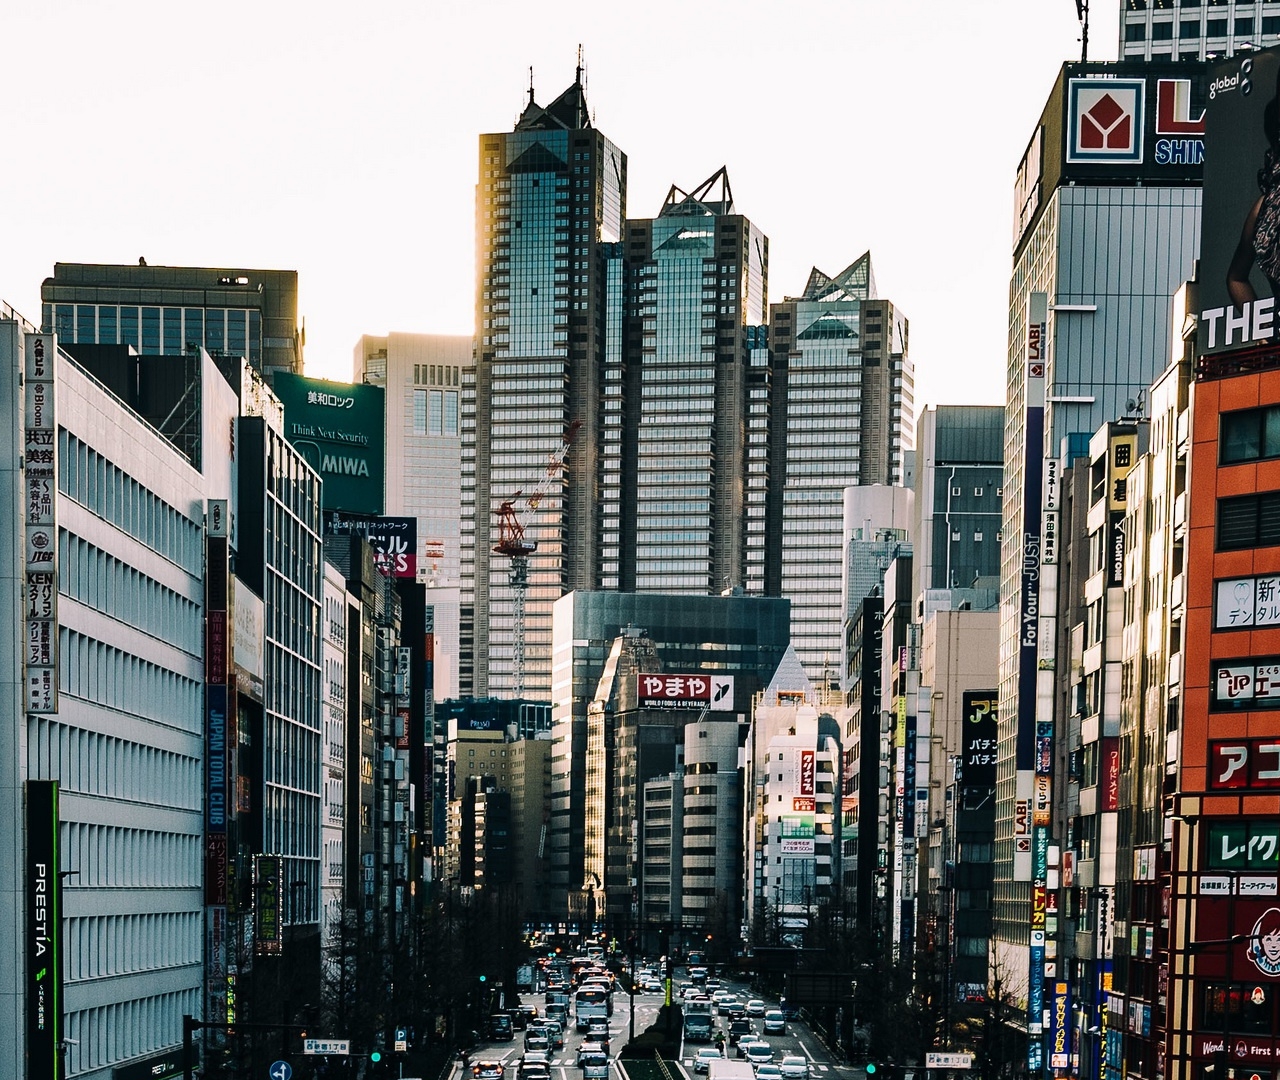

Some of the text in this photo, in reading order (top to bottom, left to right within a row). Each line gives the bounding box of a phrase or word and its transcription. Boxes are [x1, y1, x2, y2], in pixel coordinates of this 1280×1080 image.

[1209, 72, 1240, 100] global
[1155, 78, 1206, 135] L
[1028, 324, 1040, 360] LABI
[33, 338, 44, 377] 久保ビル
[34, 395, 43, 427] Bloom
[307, 390, 355, 409] 美和ロック
[25, 430, 54, 446] 共立
[291, 422, 369, 445] Think Next Security
[25, 449, 54, 464] 美容
[321, 454, 370, 478] MIWA
[29, 479, 41, 522] 美容外科
[27, 573, 53, 585] KEN
[29, 585, 39, 618] スクール
[42, 585, 52, 618] パソコン
[30, 622, 39, 664] クリニック
[1022, 625, 1037, 647] For
[643, 676, 707, 698] やまや
[210, 709, 224, 826] JAPAN TOTAL CLUB
[1016, 801, 1027, 835] LABI
[1240, 882, 1277, 890] エーアイアール
[1032, 889, 1046, 925] トレカ
[1250, 1046, 1271, 1056] First
